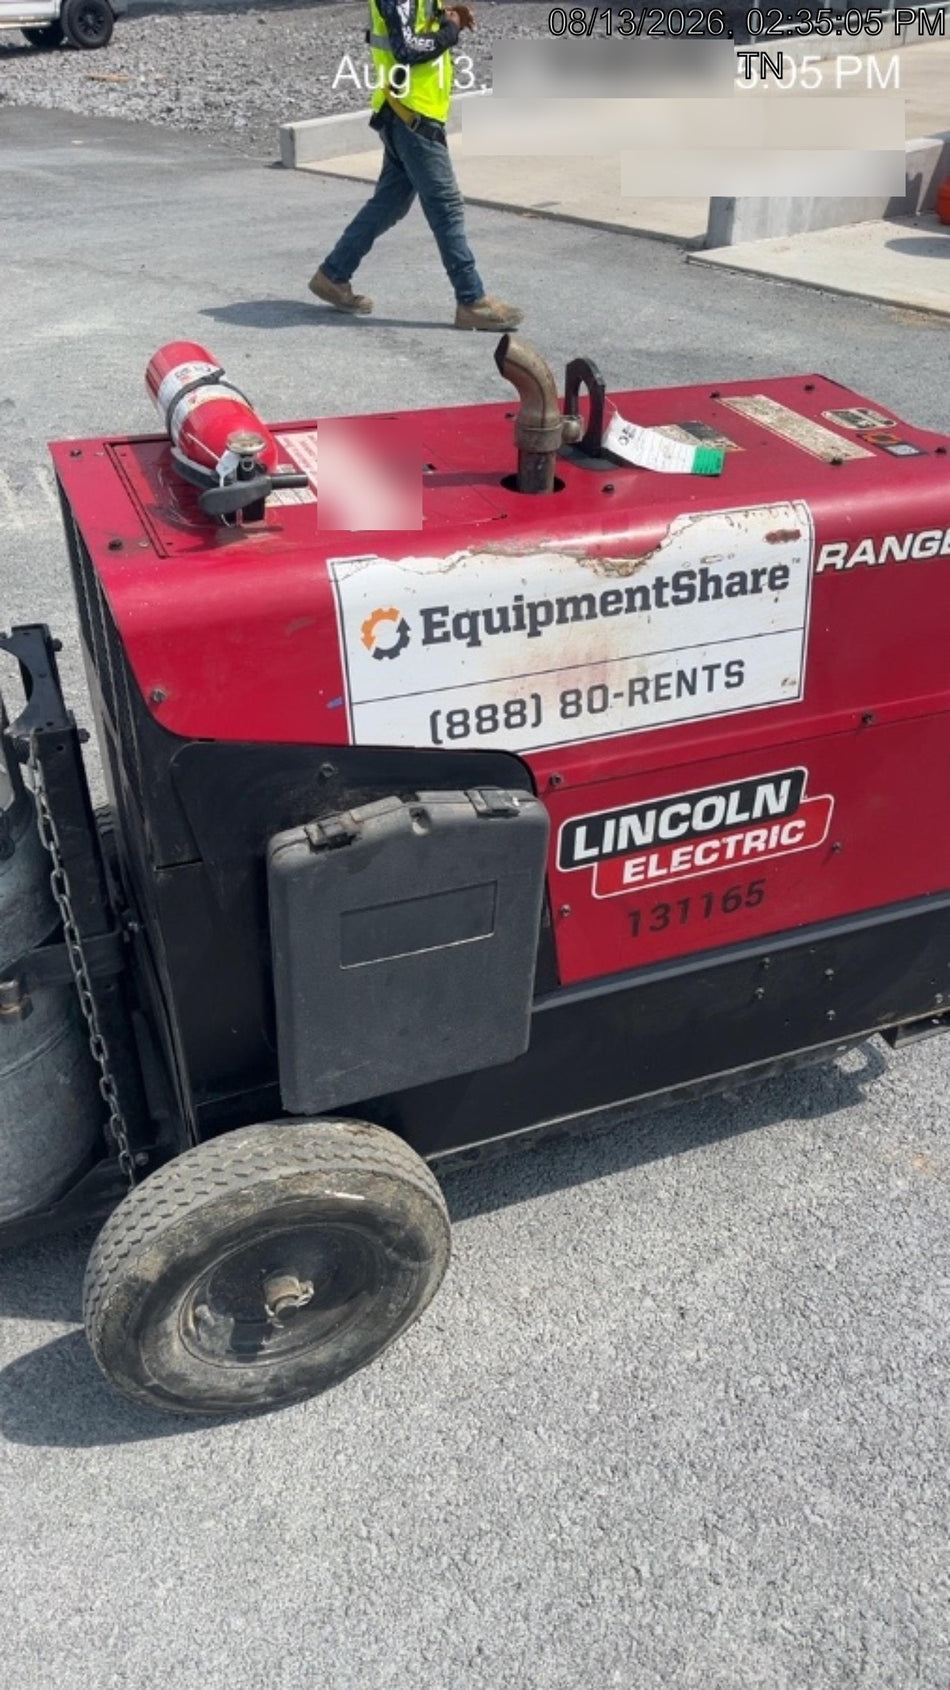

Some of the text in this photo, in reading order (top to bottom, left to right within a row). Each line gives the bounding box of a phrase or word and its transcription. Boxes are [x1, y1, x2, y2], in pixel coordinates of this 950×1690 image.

[420, 563, 790, 648] EquipmentShare
[429, 659, 746, 745] (888) 80-RENTS
[573, 779, 791, 861] LINCOLN
[622, 819, 806, 885] ELECTRIC
[627, 878, 767, 938] 131165
